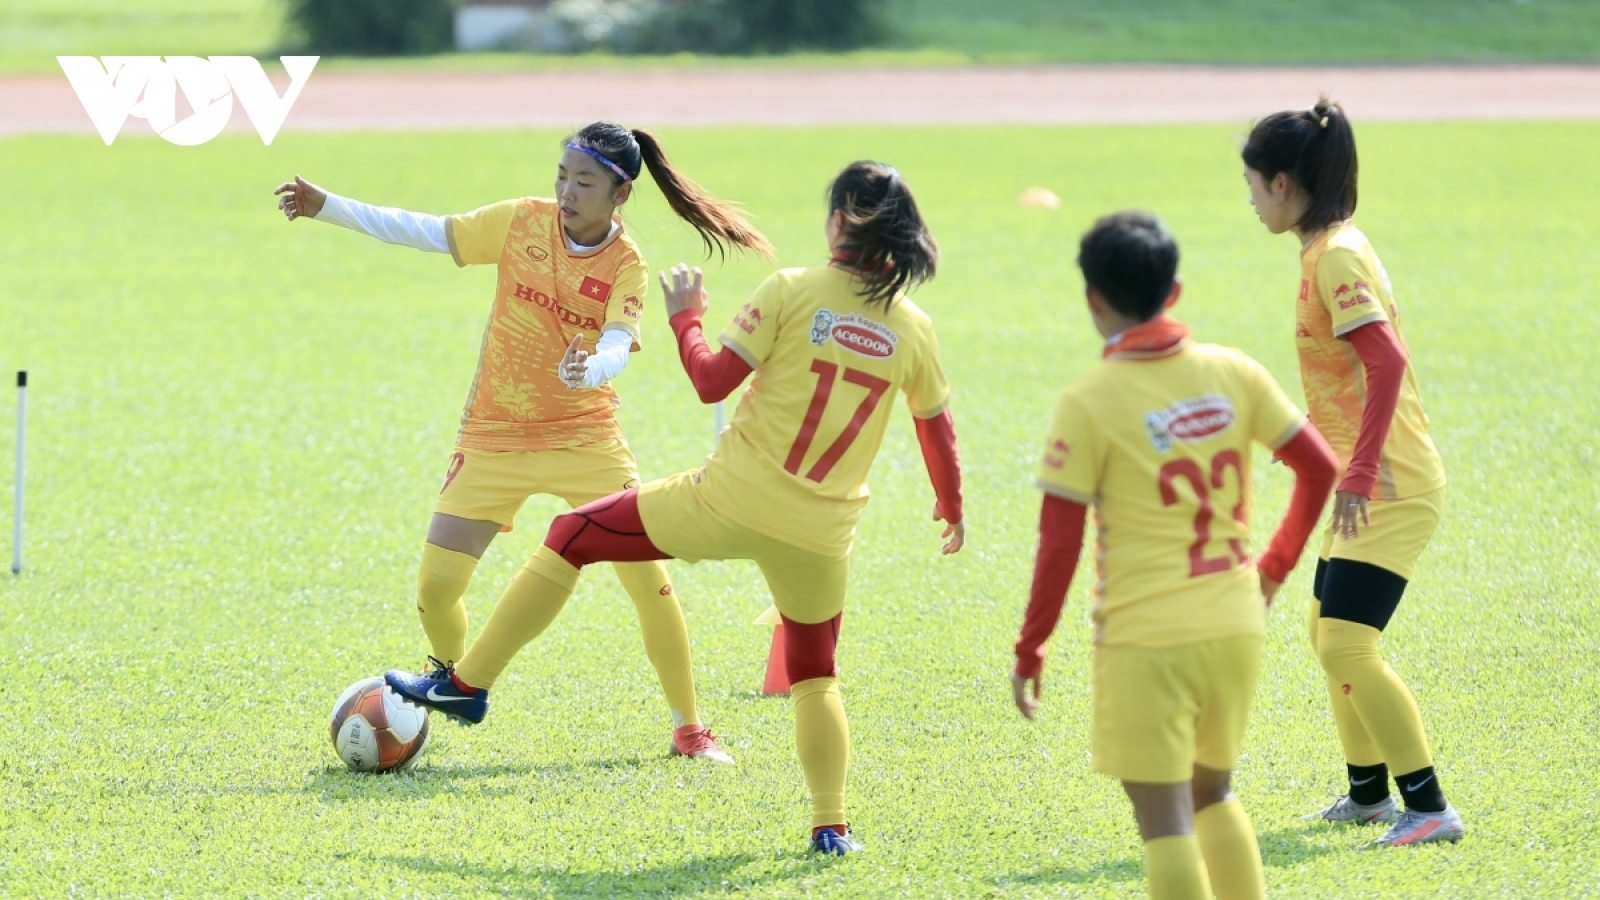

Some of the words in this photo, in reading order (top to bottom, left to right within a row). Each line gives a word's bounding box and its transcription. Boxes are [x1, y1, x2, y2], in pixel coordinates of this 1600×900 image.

[513, 282, 602, 332] HONDA
[834, 314, 855, 322] Cook
[858, 315, 897, 342] happiness
[783, 358, 892, 483] 17
